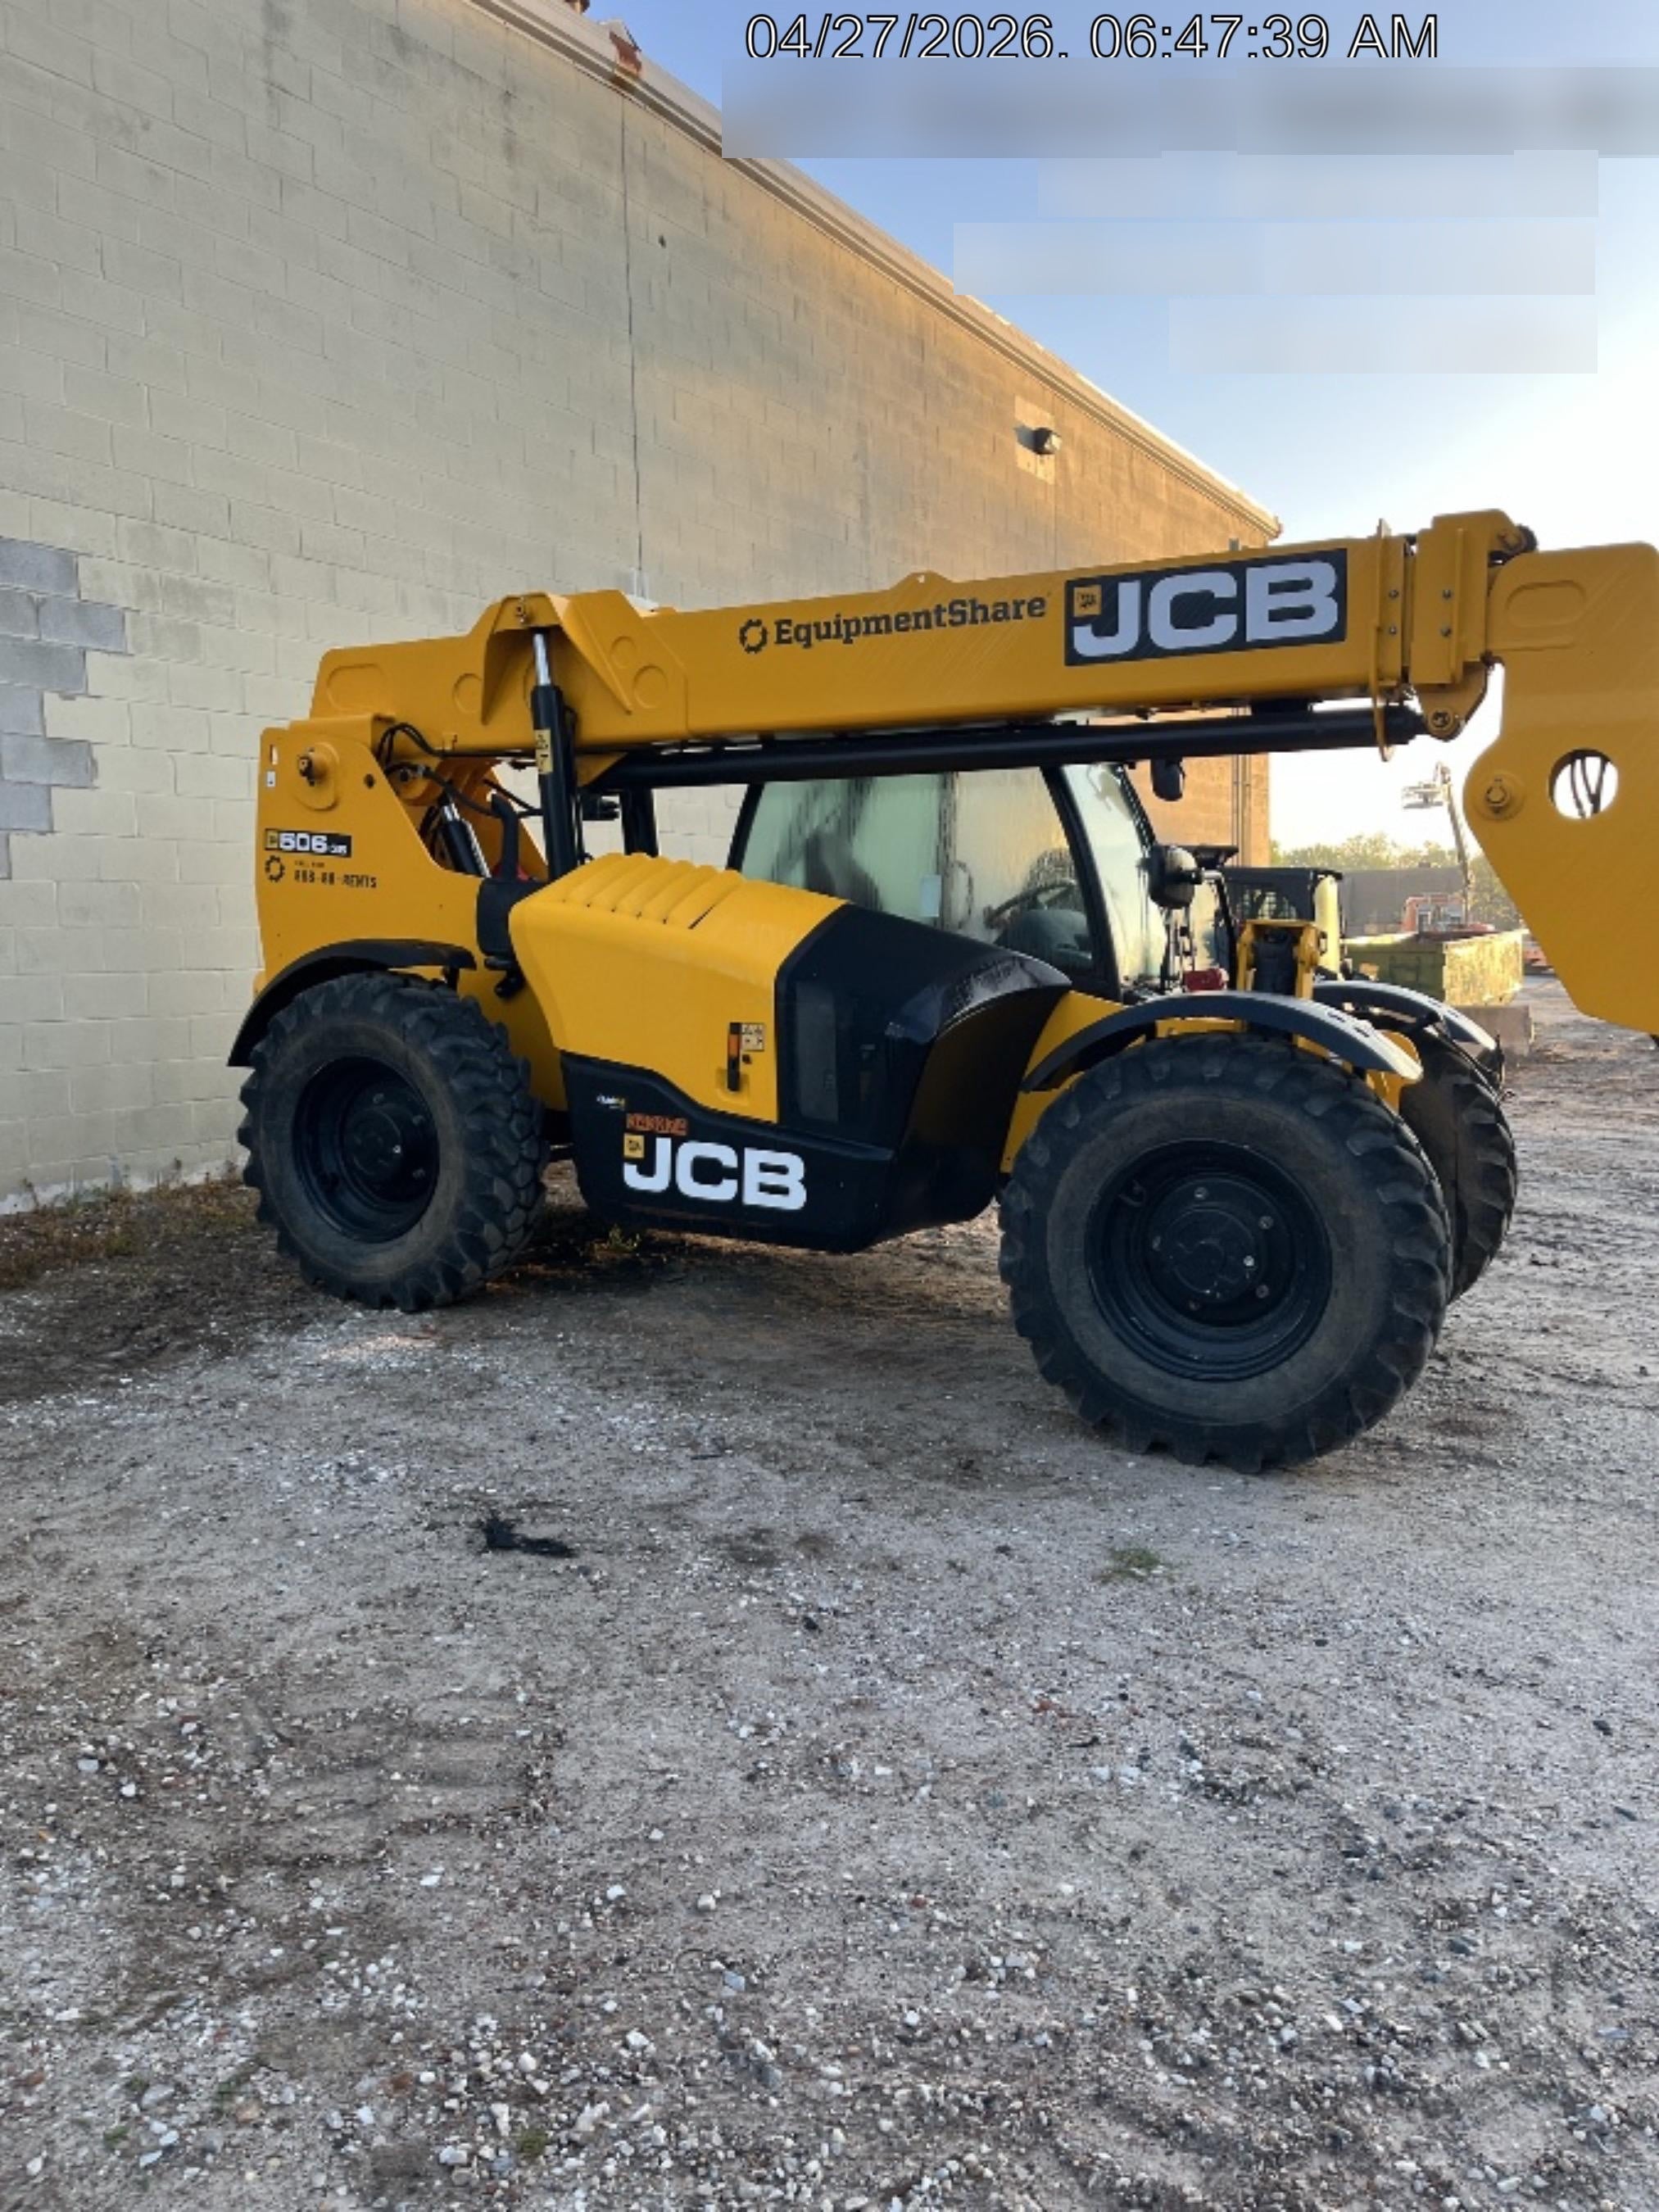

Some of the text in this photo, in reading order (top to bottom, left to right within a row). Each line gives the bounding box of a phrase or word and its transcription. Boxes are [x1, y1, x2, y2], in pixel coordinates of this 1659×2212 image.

[773, 595, 1047, 649] EquipmentShare
[1072, 560, 1338, 657] JCB
[623, 1137, 807, 1210] JCB
